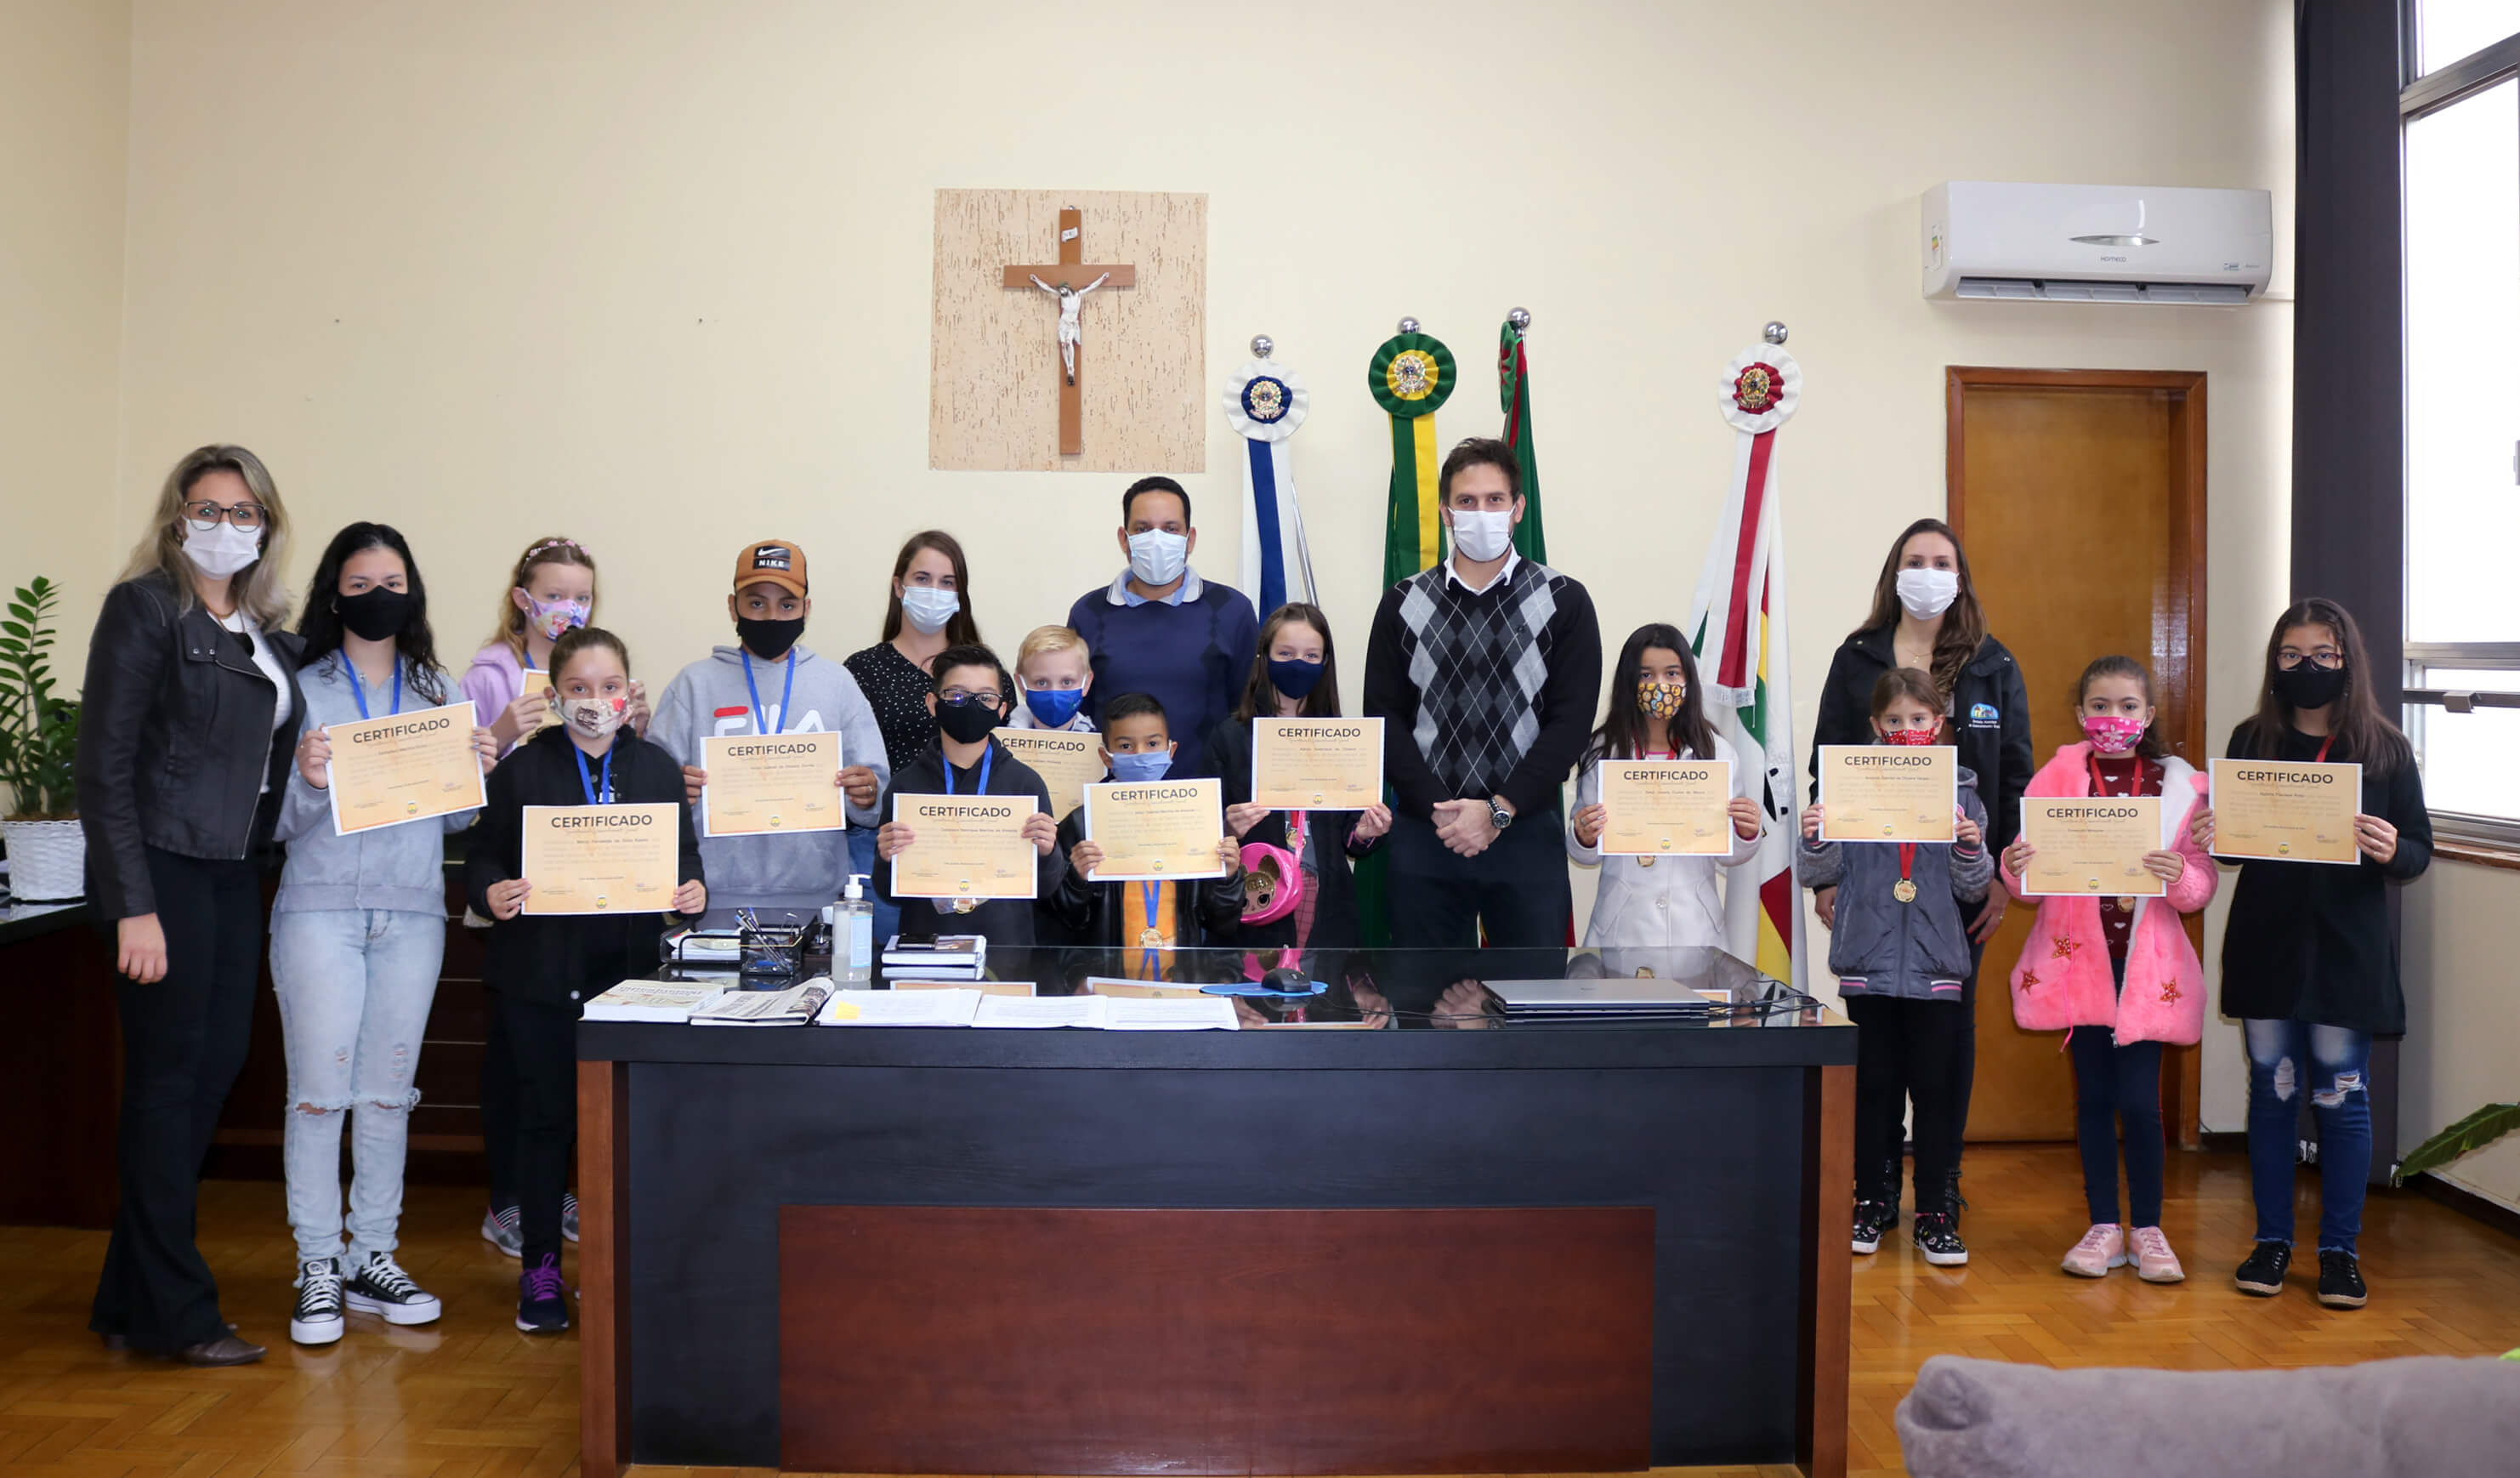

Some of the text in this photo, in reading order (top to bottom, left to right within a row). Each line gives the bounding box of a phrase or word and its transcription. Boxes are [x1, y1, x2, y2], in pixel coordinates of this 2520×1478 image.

[758, 560, 785, 568] NIKE
[353, 718, 450, 743] CERTIFICADO
[1278, 728, 1361, 737] CERTIFICADO
[728, 742, 817, 757] CERTIFICADO
[1002, 737, 1086, 752] CERTIFICADO
[1844, 755, 1933, 766] CERTIFICADO
[1623, 770, 1709, 781] CERTIFICADO
[2237, 770, 2334, 784] CERTIFICADO
[1111, 787, 1198, 801] CERTIFICADO
[919, 805, 1012, 817] CERTIFICADO
[2046, 808, 2138, 818] CERTIFICADO
[551, 815, 652, 828] CERTIFICADO
